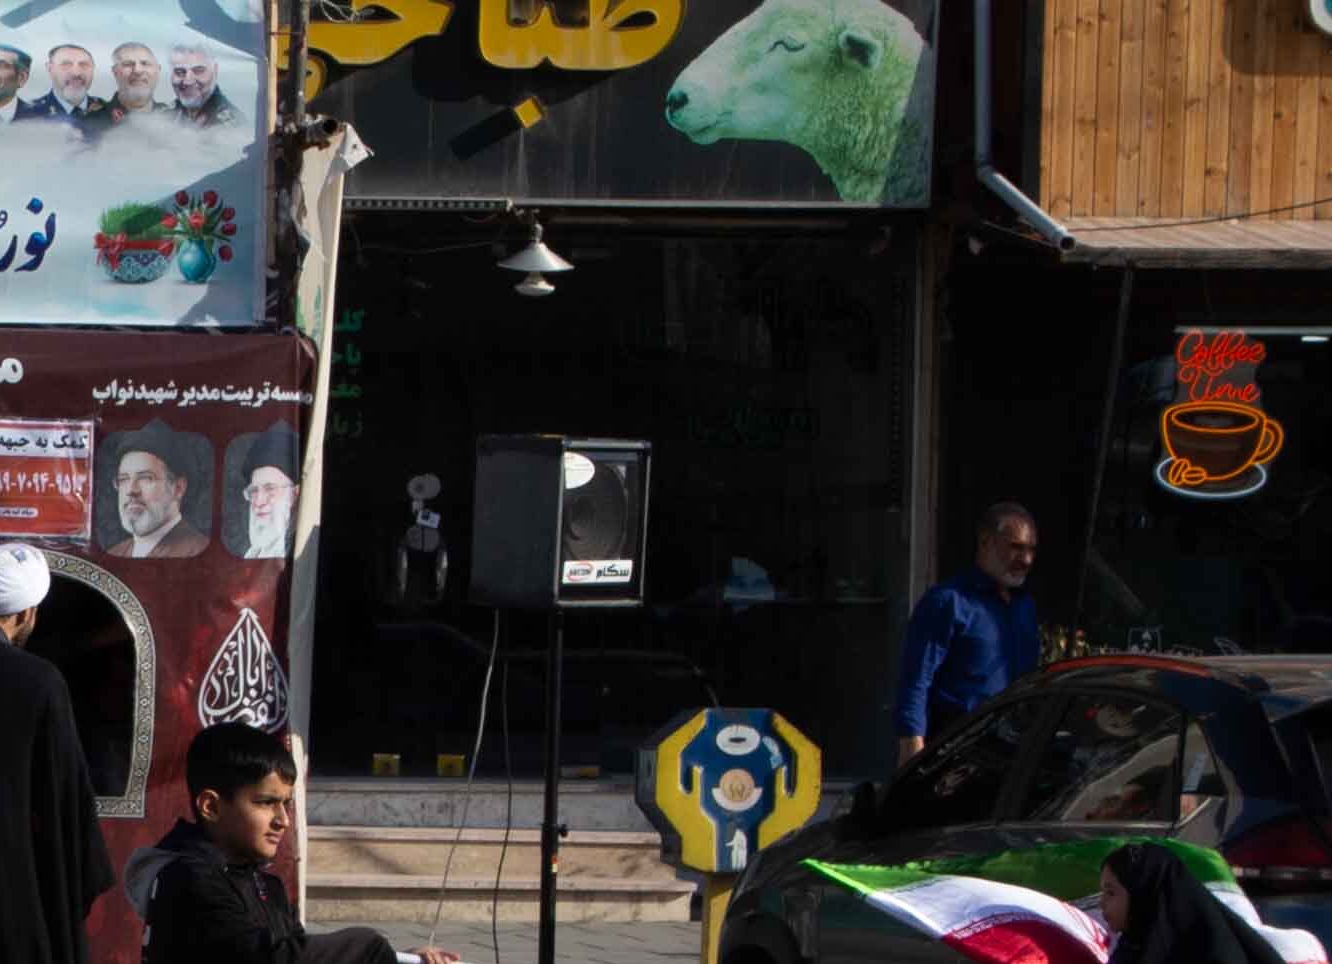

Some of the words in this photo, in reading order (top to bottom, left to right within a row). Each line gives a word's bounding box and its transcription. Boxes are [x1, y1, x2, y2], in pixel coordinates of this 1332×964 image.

[1176, 328, 1266, 369] Coffee
[92, 379, 134, 405] نواب
[134, 380, 178, 405] شهید
[177, 383, 221, 407] مدیر
[222, 381, 271, 408] تربیت
[35, 435, 49, 452] به
